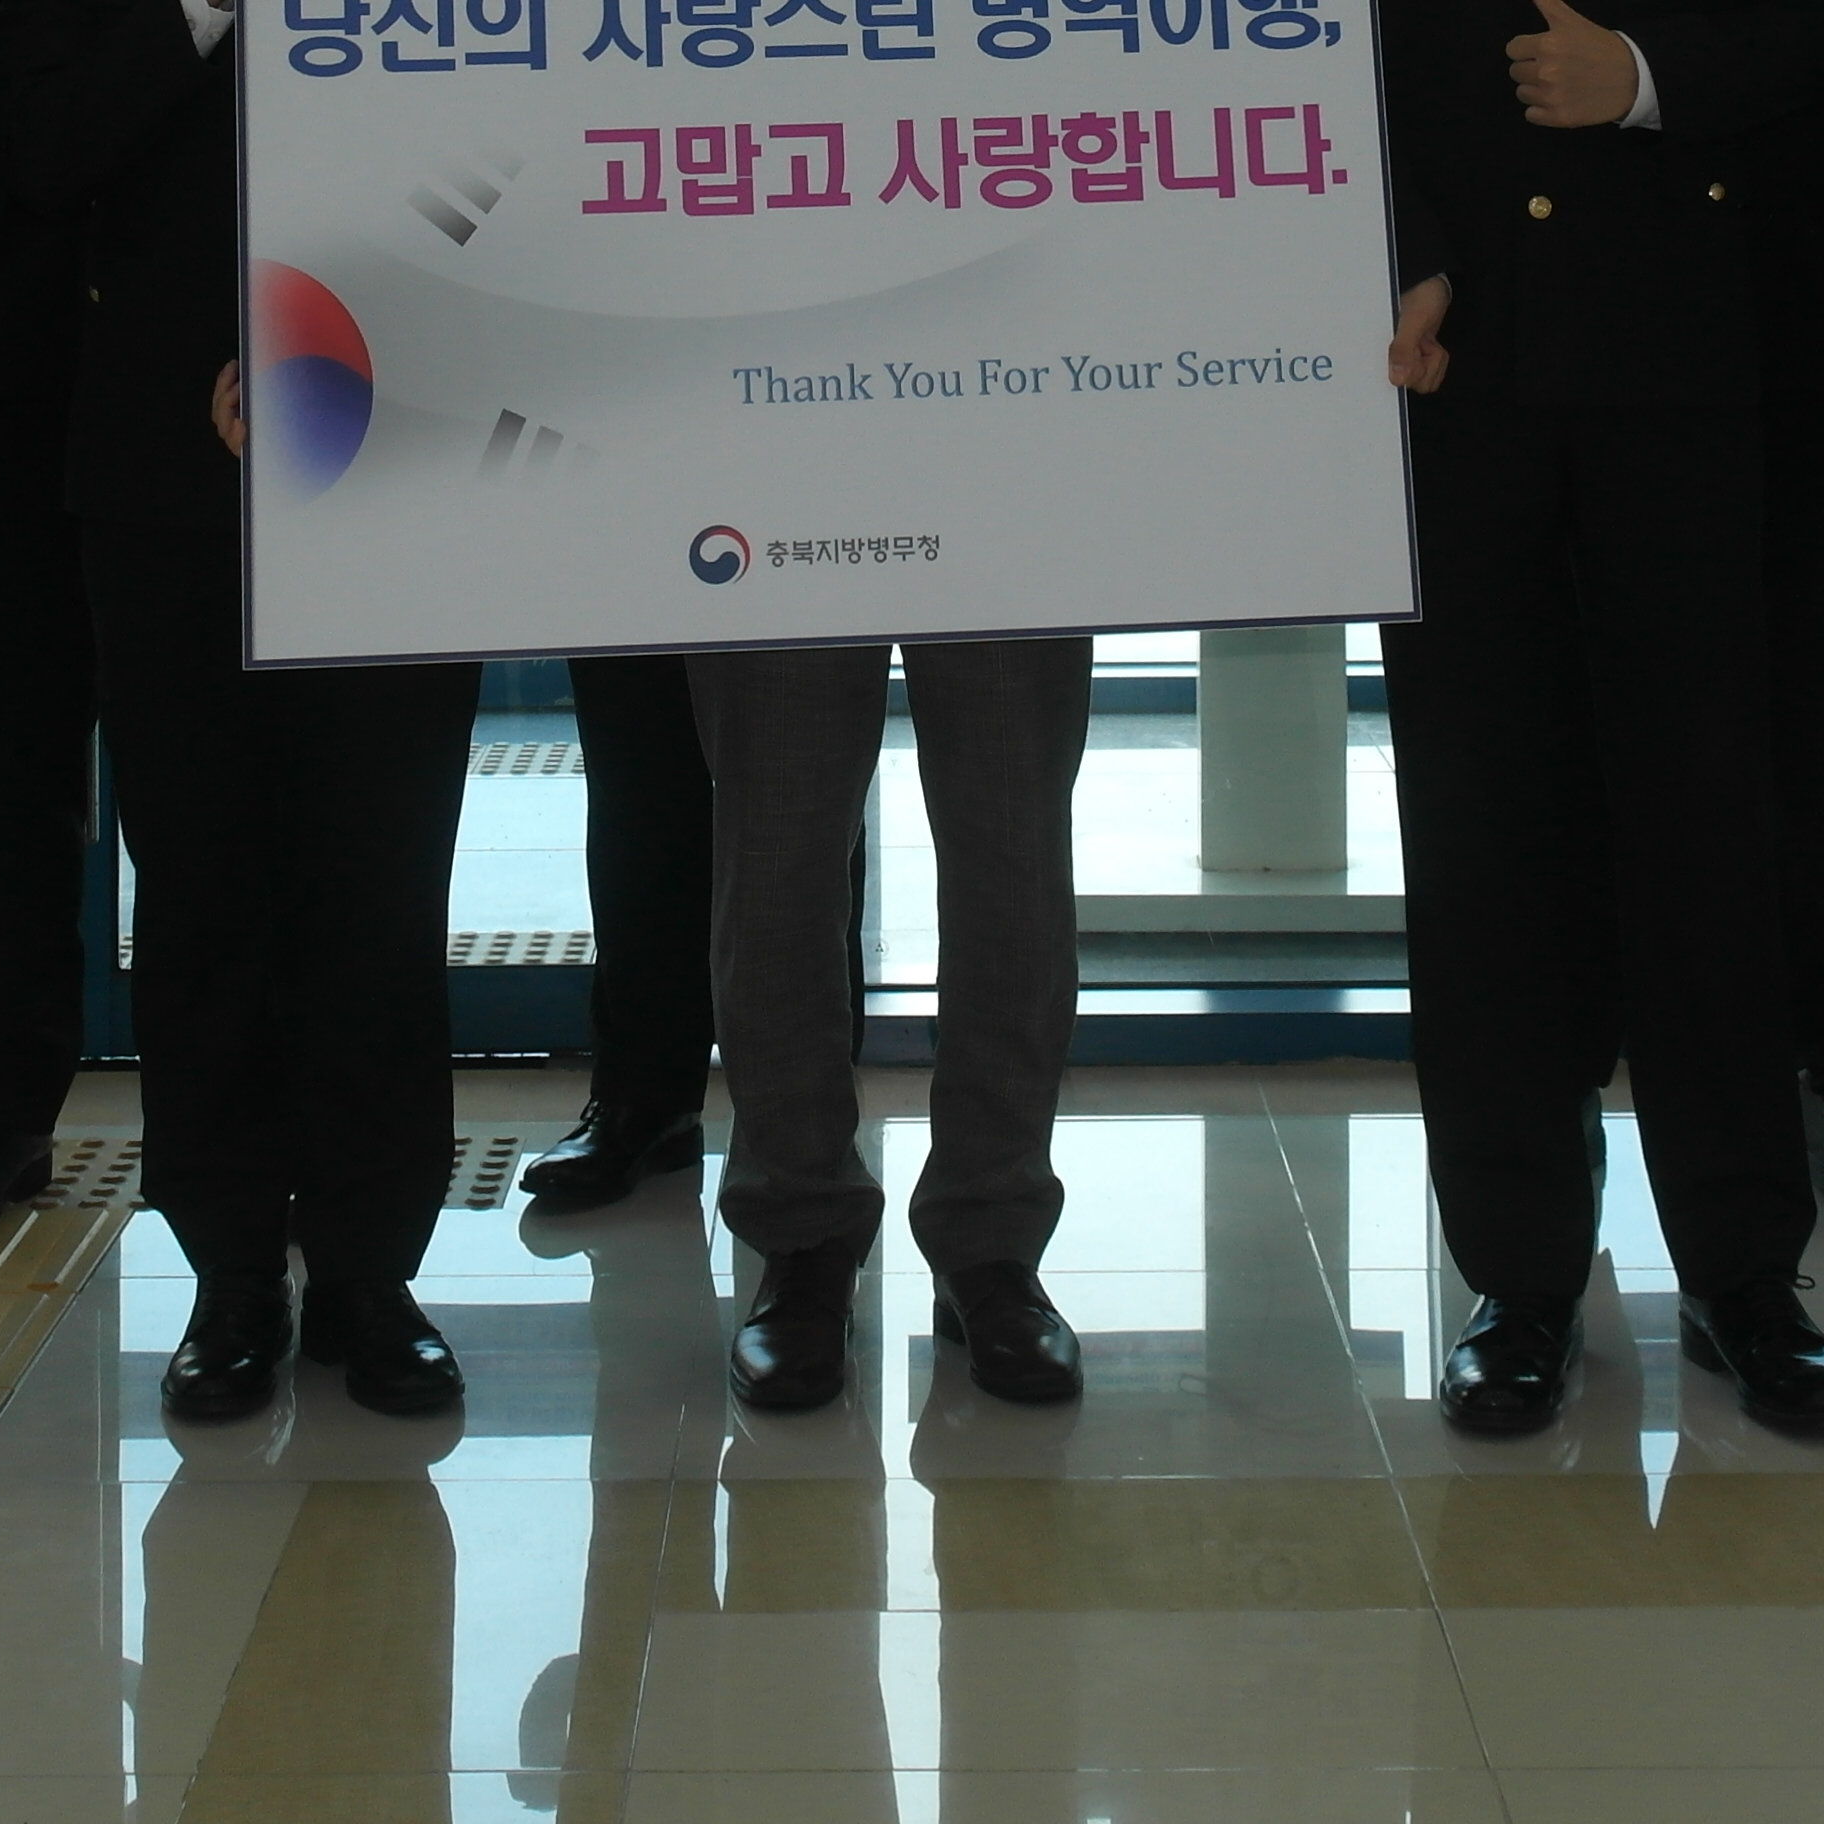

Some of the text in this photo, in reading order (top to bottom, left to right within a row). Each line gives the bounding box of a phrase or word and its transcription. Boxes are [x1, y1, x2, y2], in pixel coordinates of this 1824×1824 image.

[582, 104, 1348, 216] 고맙고 사랑합니다.
[733, 347, 1333, 405] Thank You For Your Service
[766, 535, 940, 568] 충북지방병무청
